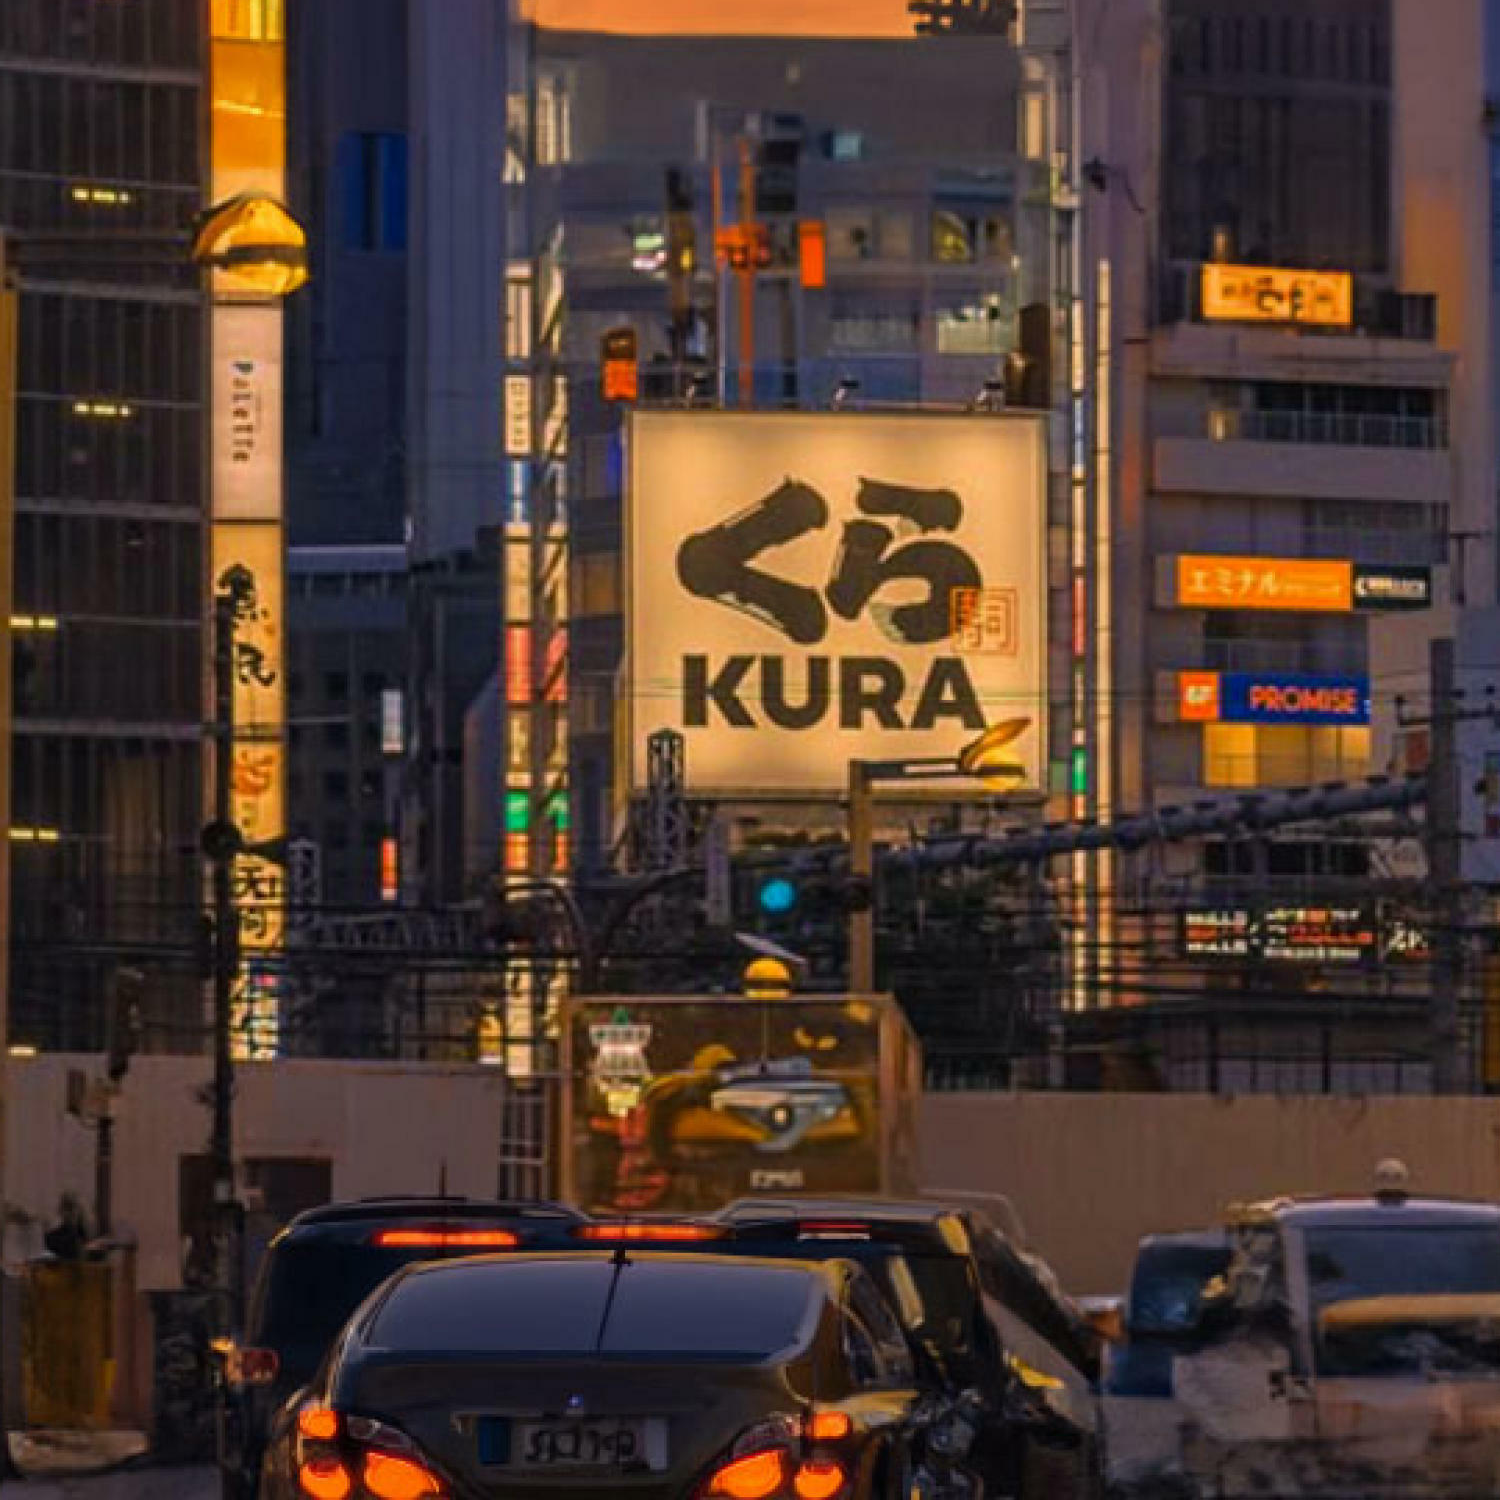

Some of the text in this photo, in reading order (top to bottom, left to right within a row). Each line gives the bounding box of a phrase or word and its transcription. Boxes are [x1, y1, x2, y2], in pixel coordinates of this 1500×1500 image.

[676, 476, 983, 645] くら
[682, 654, 987, 731] KURA
[1250, 685, 1358, 716] PROMISE
